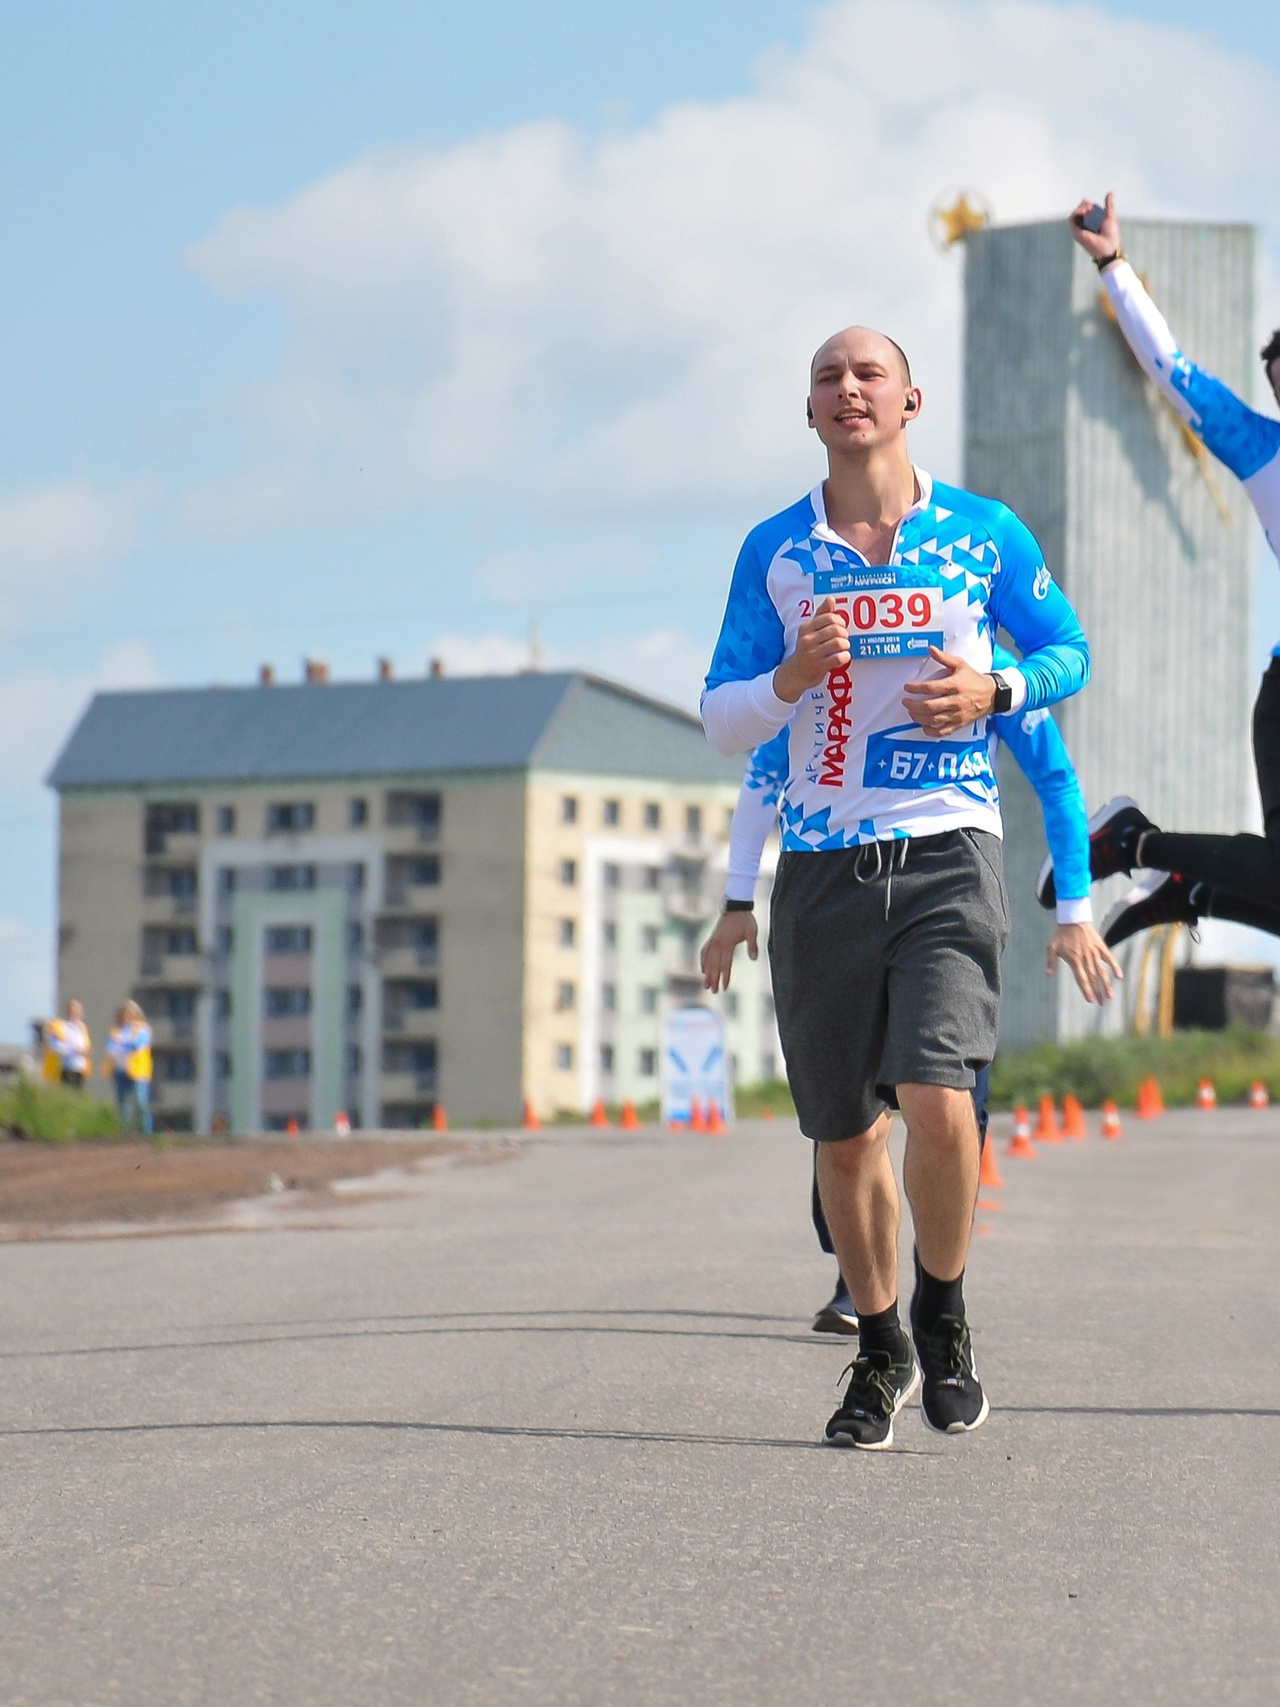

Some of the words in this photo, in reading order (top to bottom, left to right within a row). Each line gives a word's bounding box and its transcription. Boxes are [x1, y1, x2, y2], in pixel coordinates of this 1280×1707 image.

[834, 592, 932, 631] 5039
[860, 646, 880, 656] 21,1
[883, 643, 901, 654] КМ
[818, 657, 853, 788] МАРАФ
